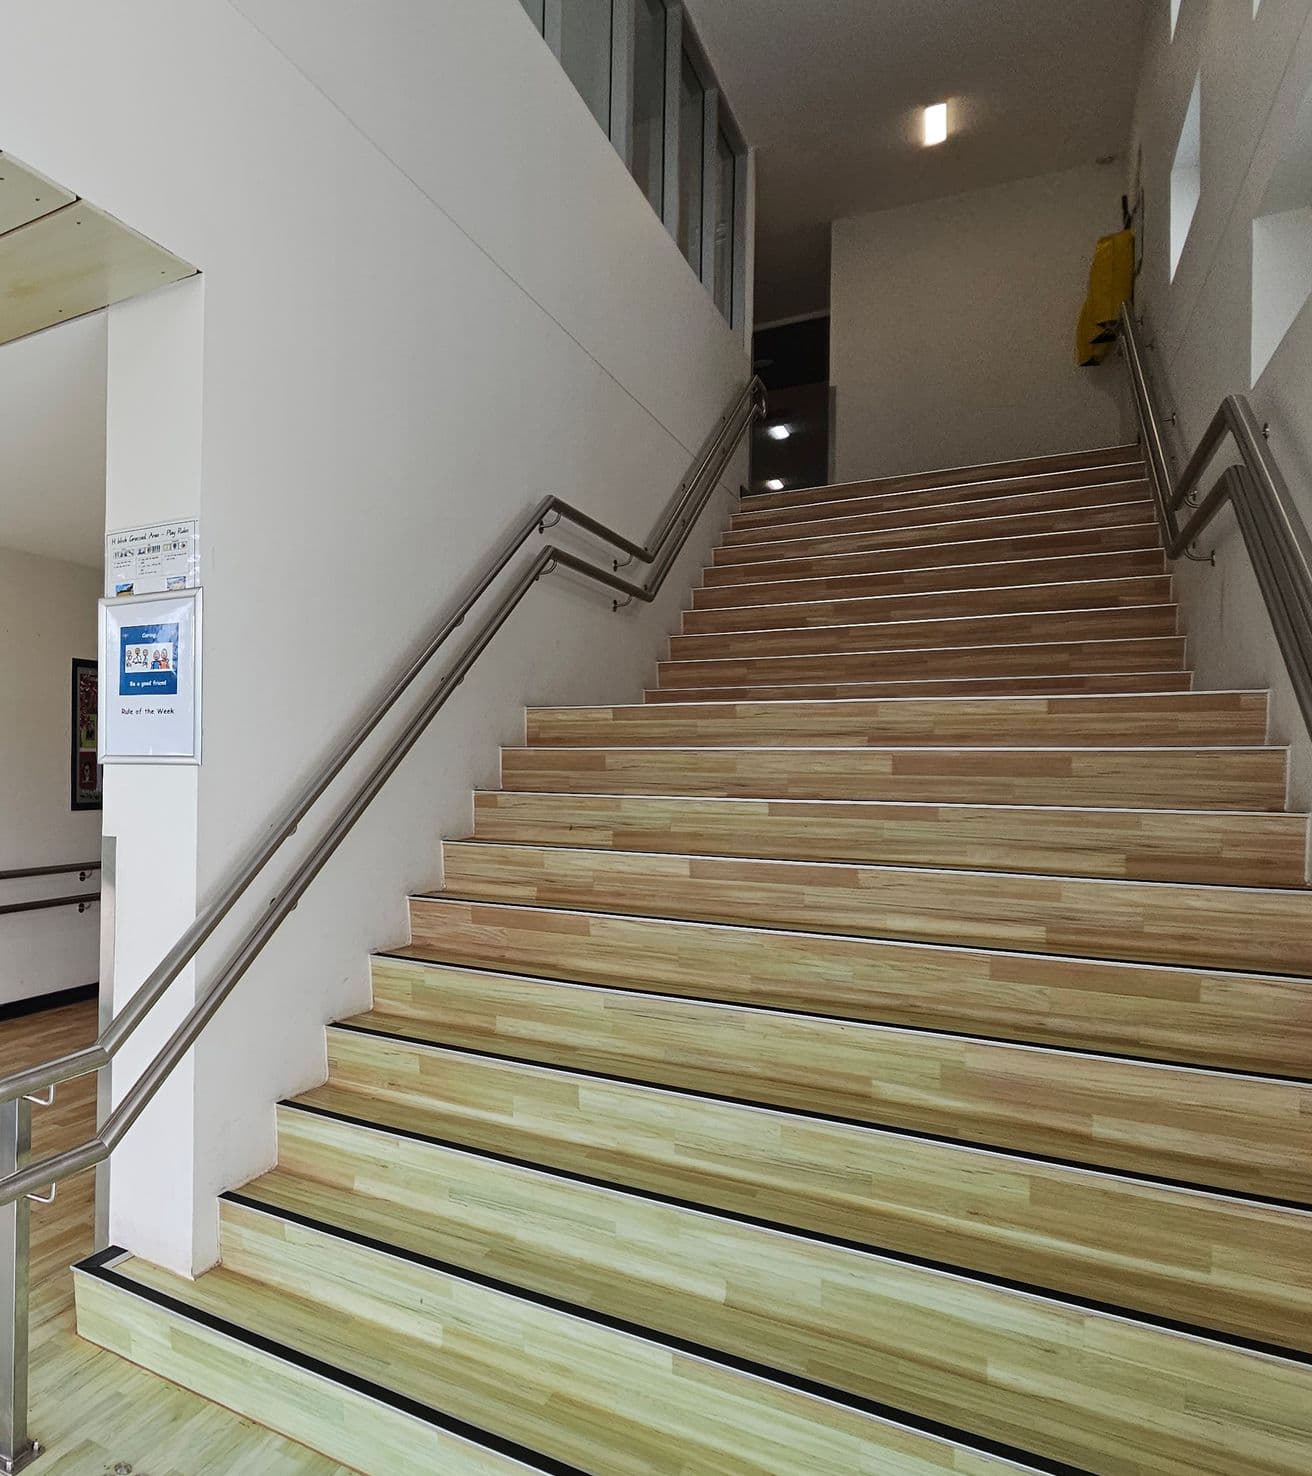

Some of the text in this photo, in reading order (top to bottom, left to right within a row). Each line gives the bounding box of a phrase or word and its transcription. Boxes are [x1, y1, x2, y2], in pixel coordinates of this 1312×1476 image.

[166, 529, 176, 538] Play
[141, 680, 152, 689] good
[121, 707, 175, 715] Rule of the Week
